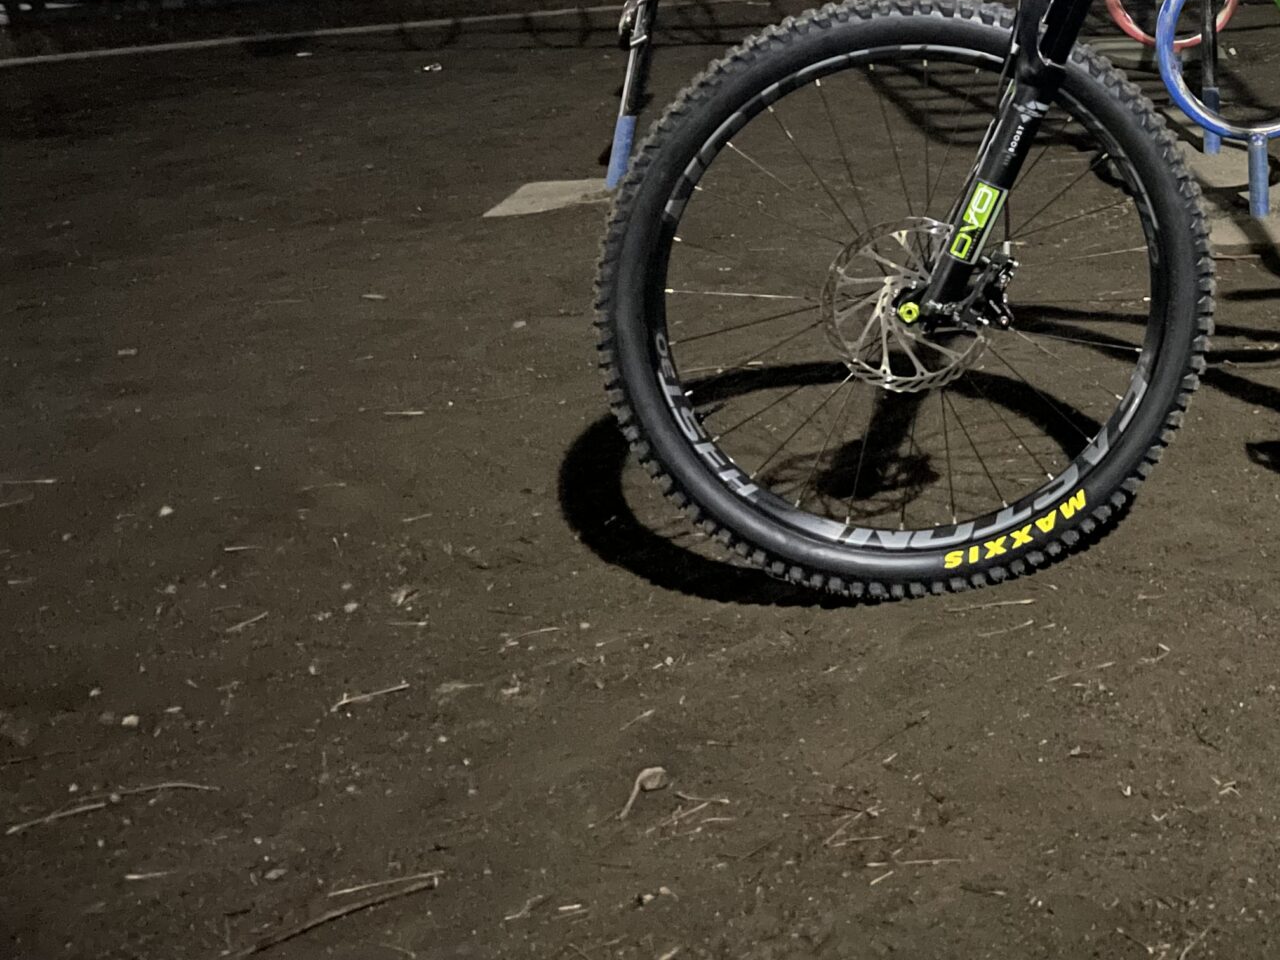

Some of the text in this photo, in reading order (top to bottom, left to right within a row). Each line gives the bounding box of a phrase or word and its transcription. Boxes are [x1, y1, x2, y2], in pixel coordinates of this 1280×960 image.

[1008, 125, 1025, 153] BOOST
[950, 186, 993, 259] DVO
[944, 489, 1087, 569] MAXXIS
